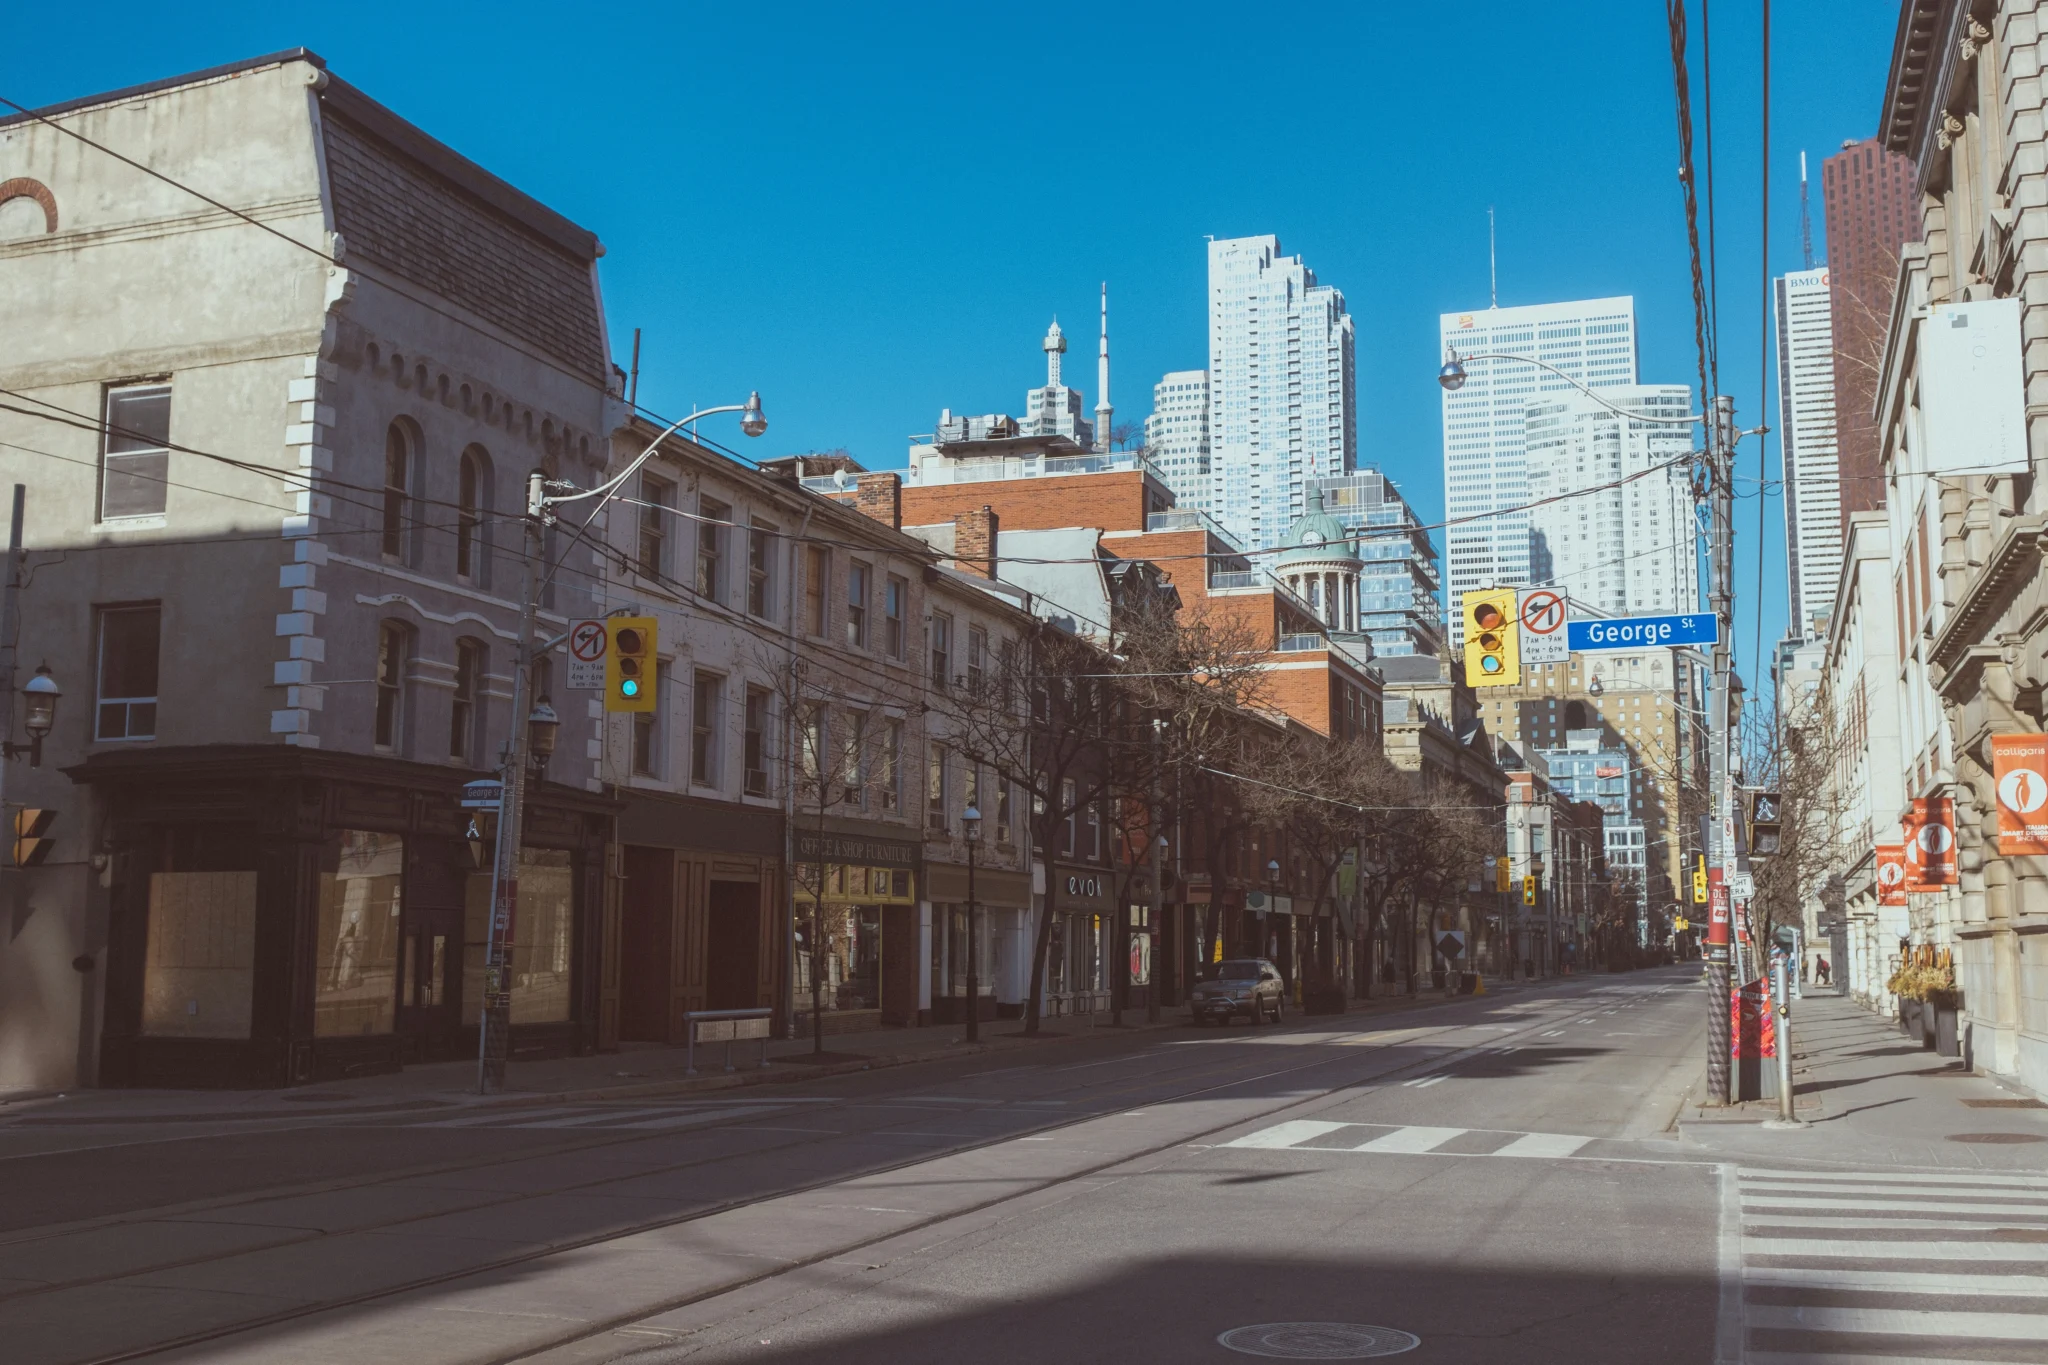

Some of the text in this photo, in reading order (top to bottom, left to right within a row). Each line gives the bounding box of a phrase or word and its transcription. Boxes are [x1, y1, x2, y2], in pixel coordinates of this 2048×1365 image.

[1790, 277, 1819, 288] BMO
[1589, 623, 1672, 645] George
[1996, 747, 2046, 757] calligaris
[467, 787, 493, 799] George
[800, 837, 913, 863] OFFCE & SHOP FURNITURE
[1069, 875, 1102, 897] evok
